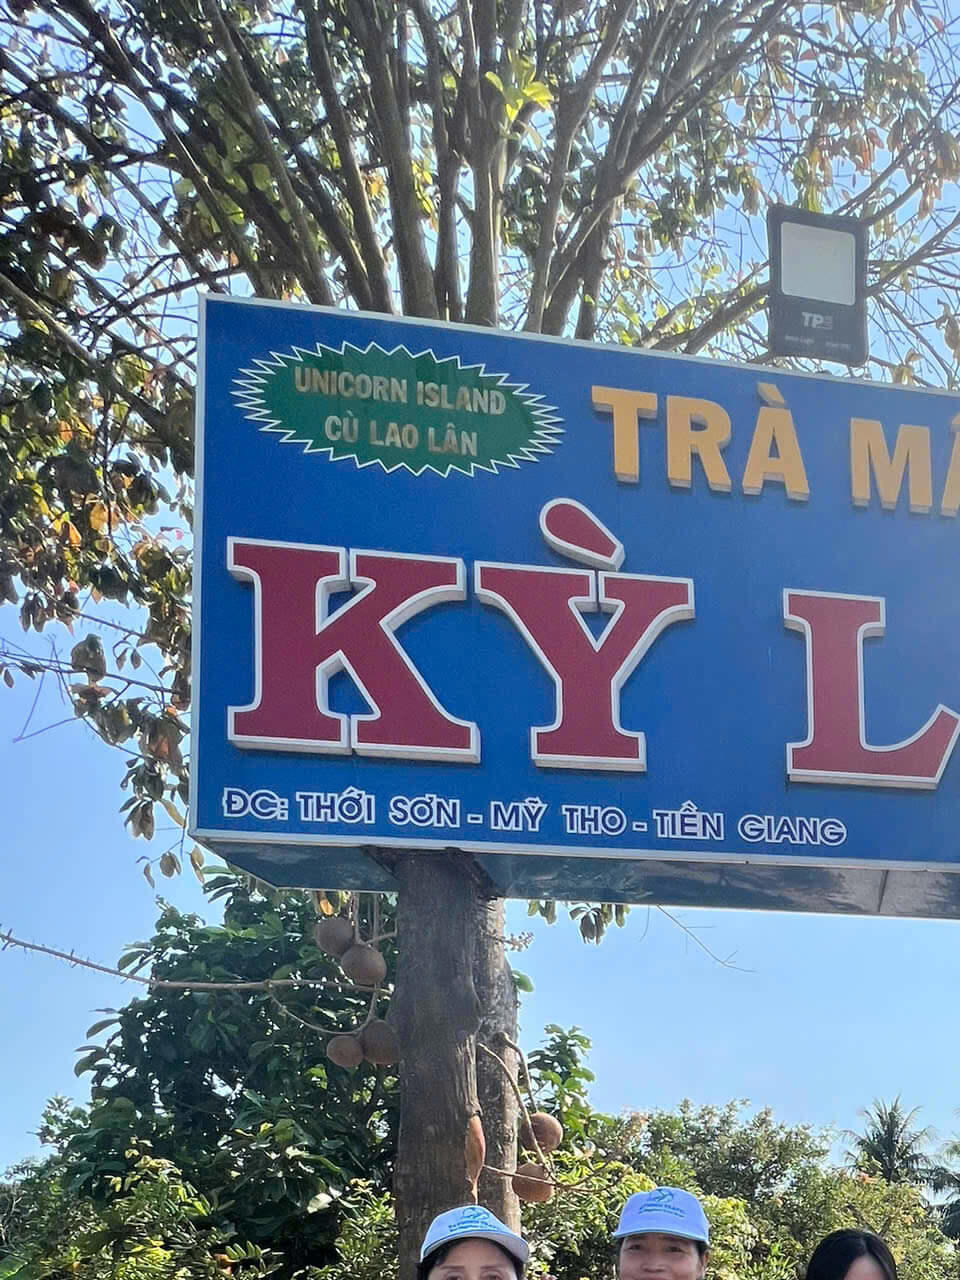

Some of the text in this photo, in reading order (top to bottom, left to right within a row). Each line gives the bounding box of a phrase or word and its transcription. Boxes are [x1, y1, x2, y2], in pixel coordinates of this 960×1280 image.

[294, 366, 506, 415] UNICORN ISLAND
[325, 410, 478, 456] CÙ LAO LÂN
[591, 382, 809, 501] TRÀ
[226, 498, 696, 772] KỲ
[222, 787, 288, 820] ĐC:
[389, 794, 460, 828] SƠN
[491, 796, 548, 832] MỸ
[562, 805, 627, 836] THO
[653, 800, 724, 840] TIỀN
[738, 814, 847, 846] GIANG
